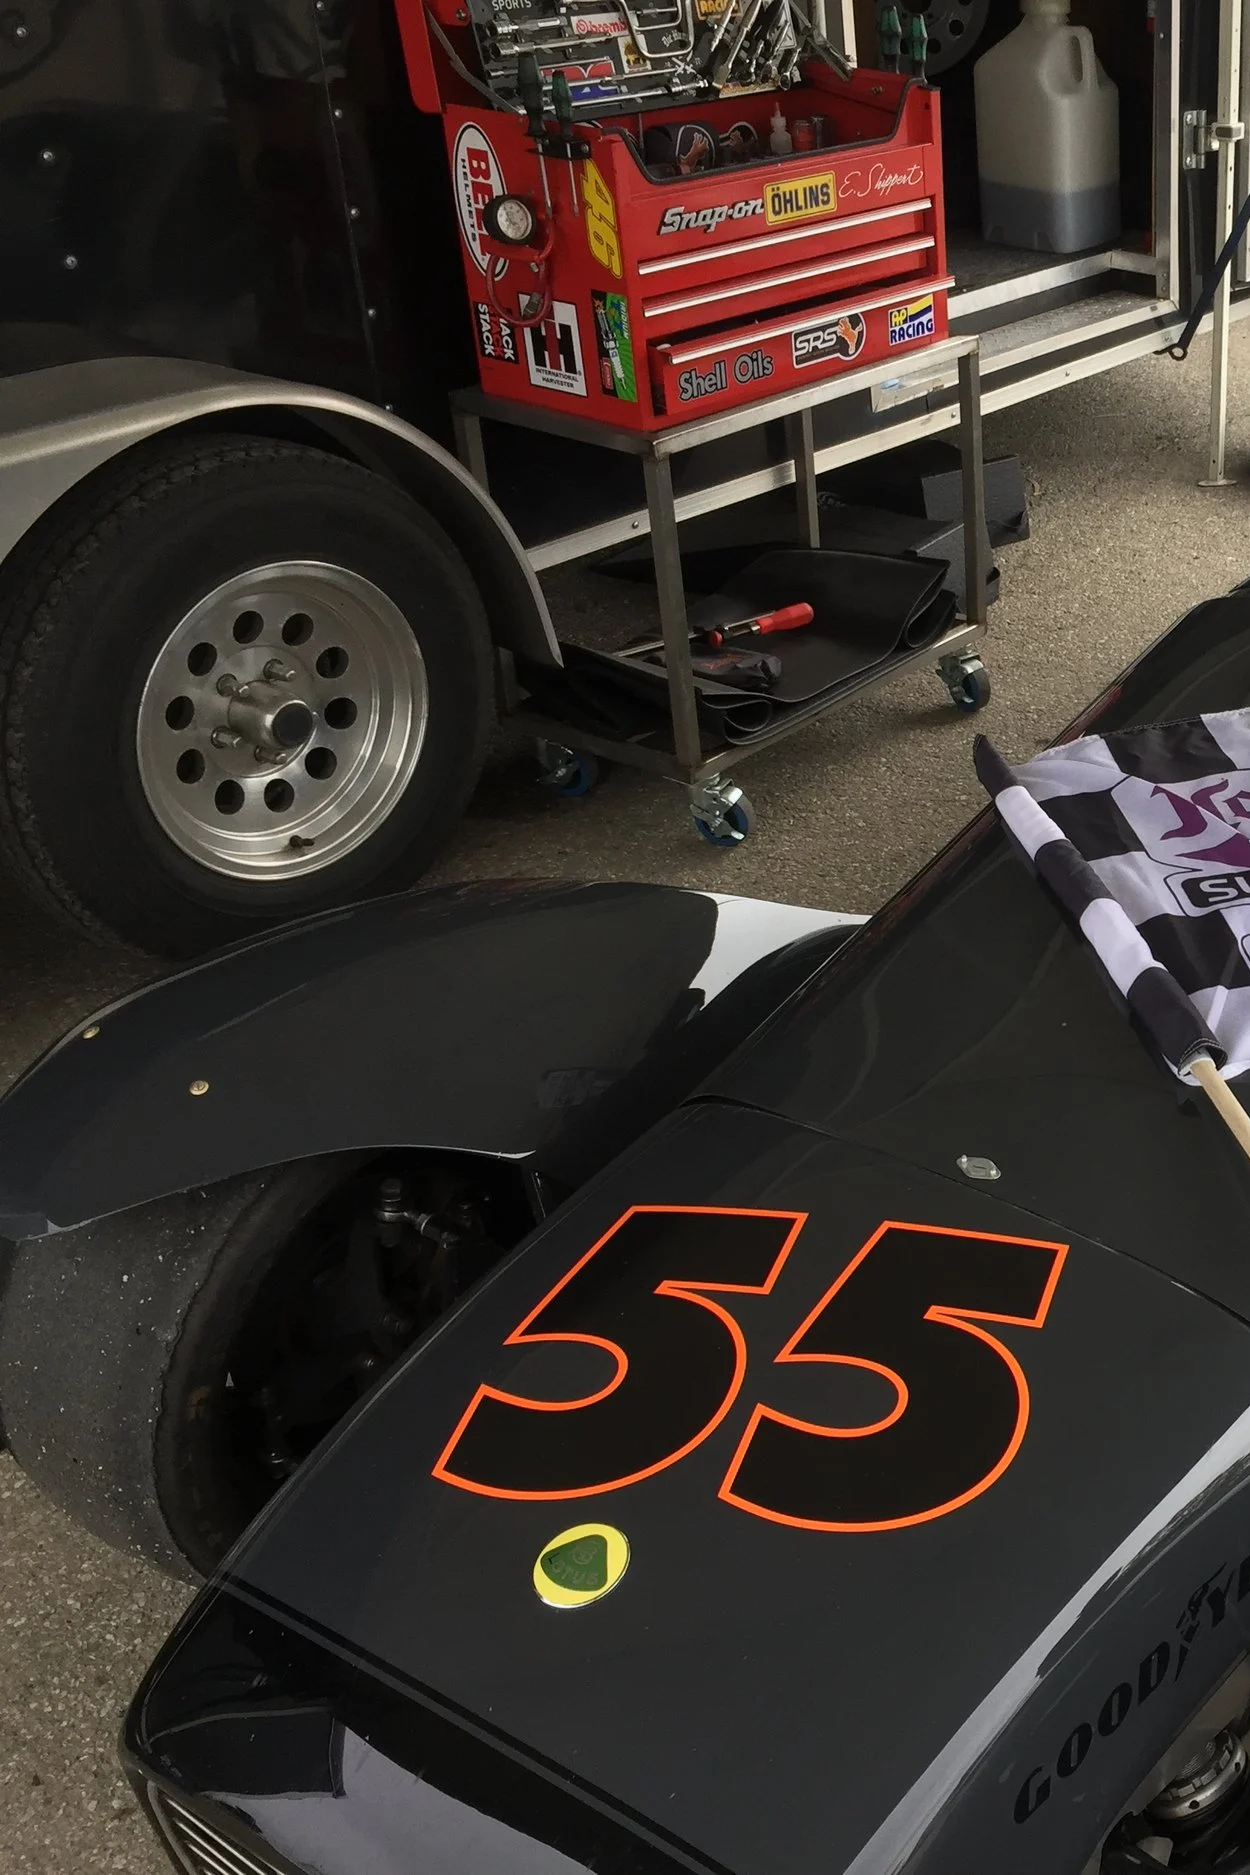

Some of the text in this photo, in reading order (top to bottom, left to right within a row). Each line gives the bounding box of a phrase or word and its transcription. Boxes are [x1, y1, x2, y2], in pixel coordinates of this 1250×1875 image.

[492, 0, 532, 11] SPORTS
[857, 163, 924, 197] Shippert
[460, 158, 477, 243] HELMETS
[657, 198, 764, 236] Snap-on
[771, 183, 831, 217] ÖHLINS
[477, 303, 495, 357] STACK
[890, 308, 908, 328] AP
[890, 318, 934, 345] RACING
[795, 330, 838, 356] SRS
[535, 367, 579, 383] INTERNATIONAL
[541, 376, 575, 389] HARVESTER
[679, 349, 774, 401] Shell Oils
[430, 1204, 1070, 1532] 55
[547, 1552, 599, 1586] LOTUS
